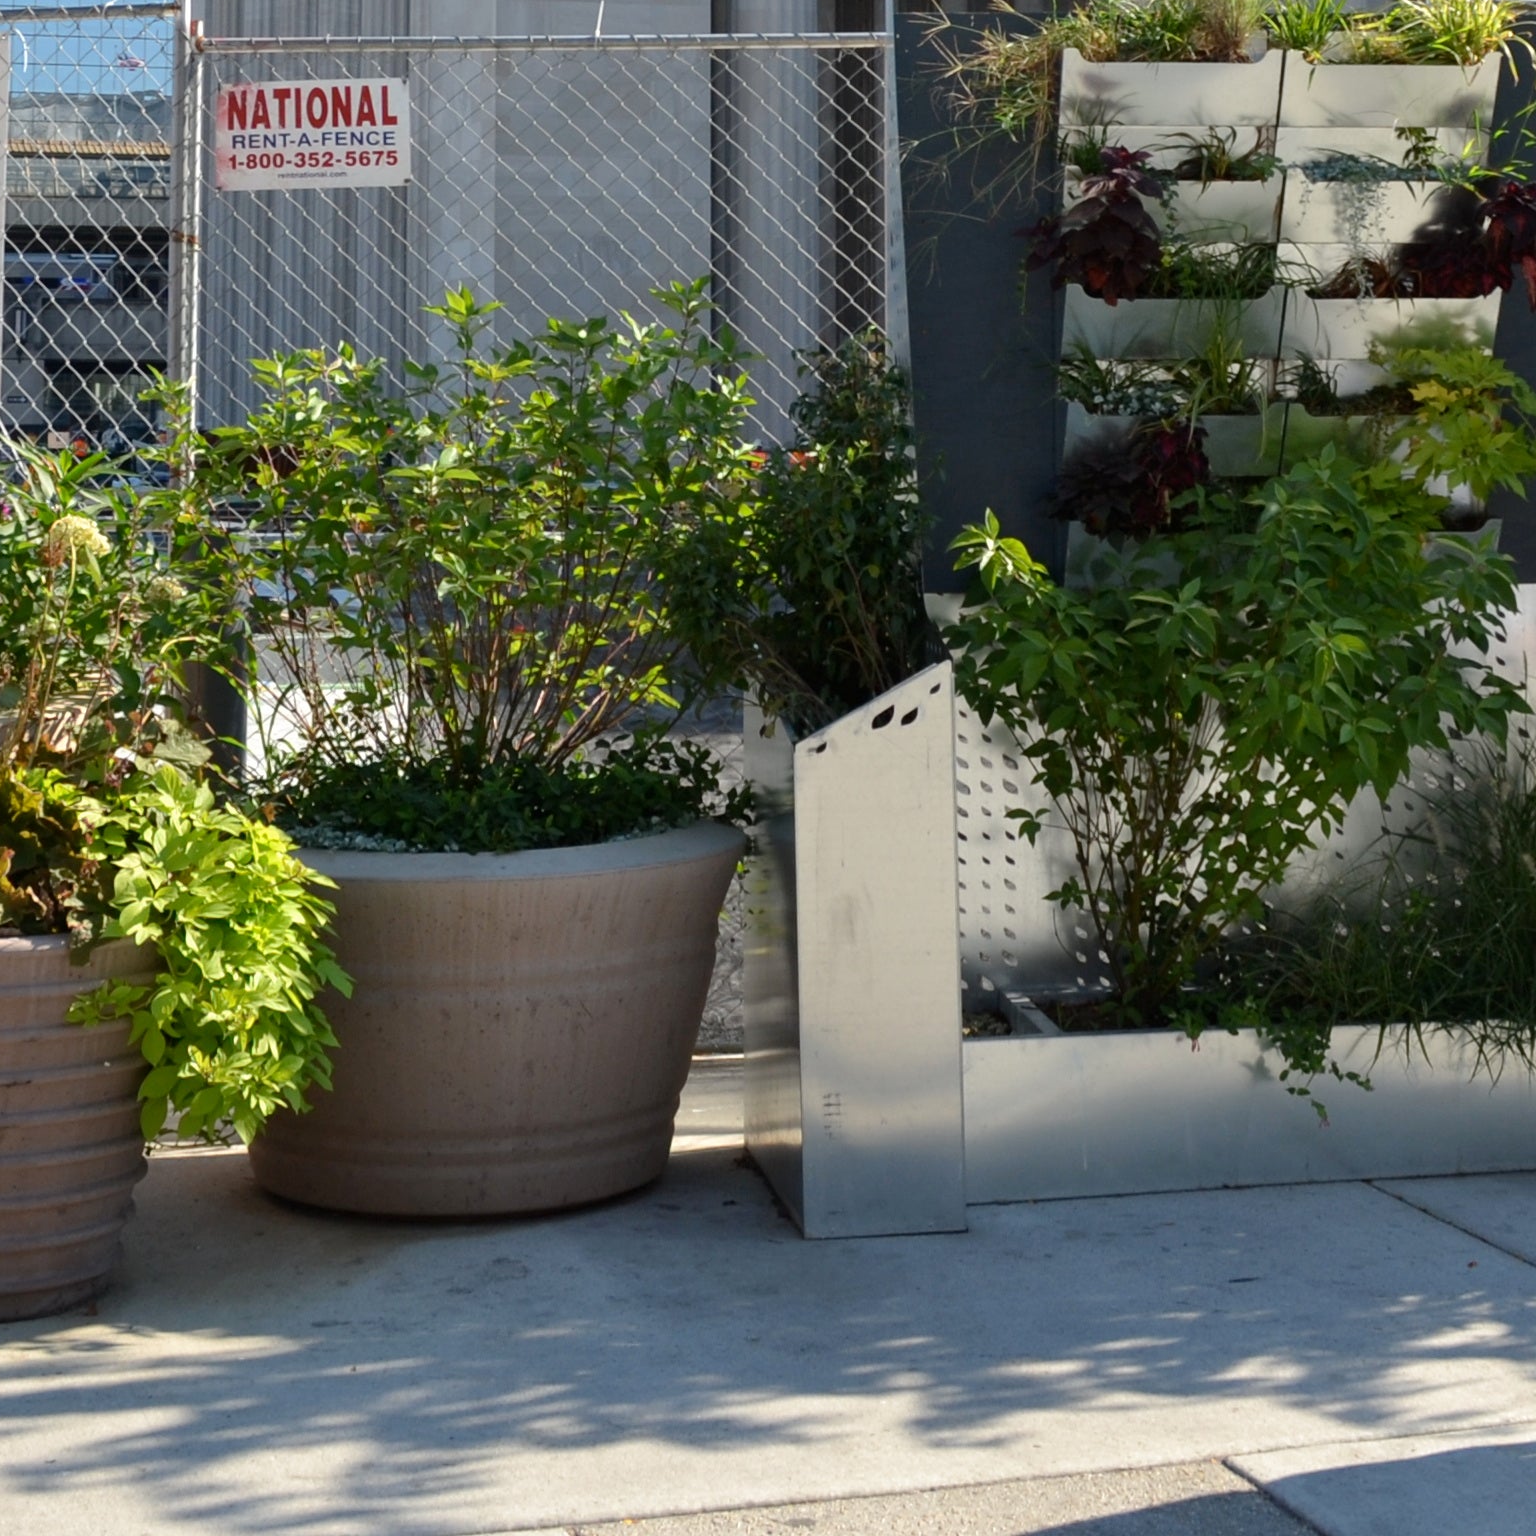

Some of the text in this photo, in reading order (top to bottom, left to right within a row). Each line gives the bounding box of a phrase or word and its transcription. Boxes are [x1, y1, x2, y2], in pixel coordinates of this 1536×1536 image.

[227, 84, 398, 131] NATIONAL
[231, 130, 396, 149] RENT-A-FENCE
[227, 150, 399, 170] 1-800-352-5675
